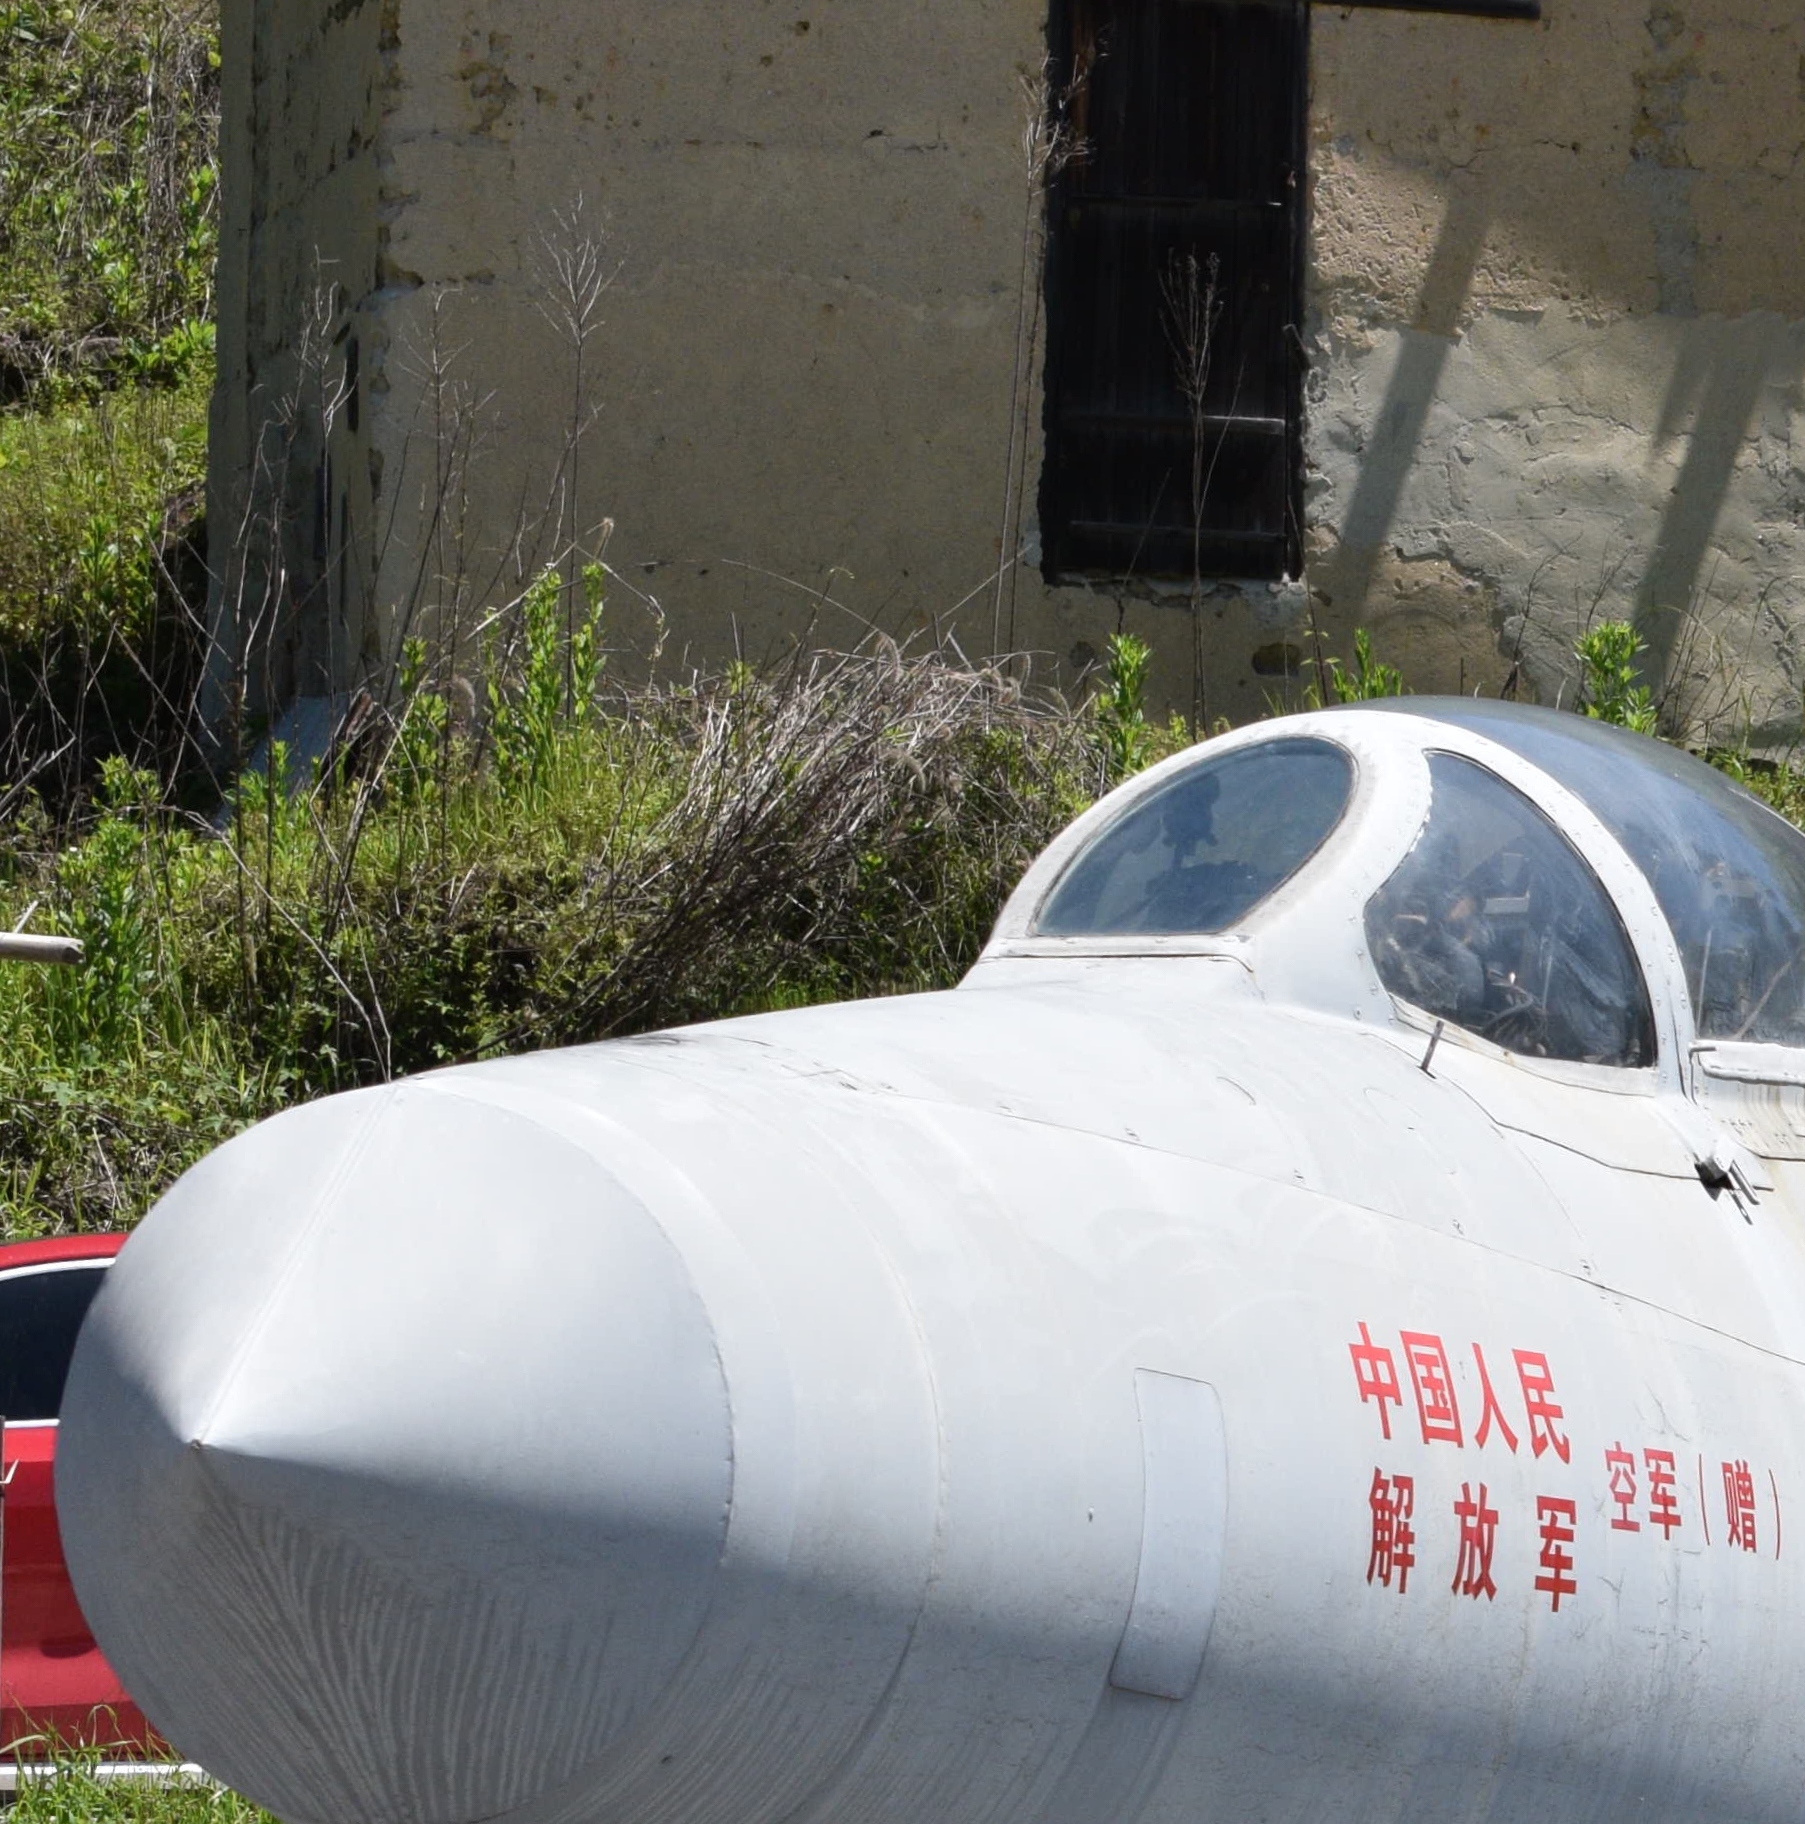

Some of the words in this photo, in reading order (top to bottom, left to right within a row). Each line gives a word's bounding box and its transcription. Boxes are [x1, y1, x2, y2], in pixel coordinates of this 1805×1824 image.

[1348, 1321, 1571, 1464] 中国人民
[1366, 1466, 1577, 1612] 解放军
